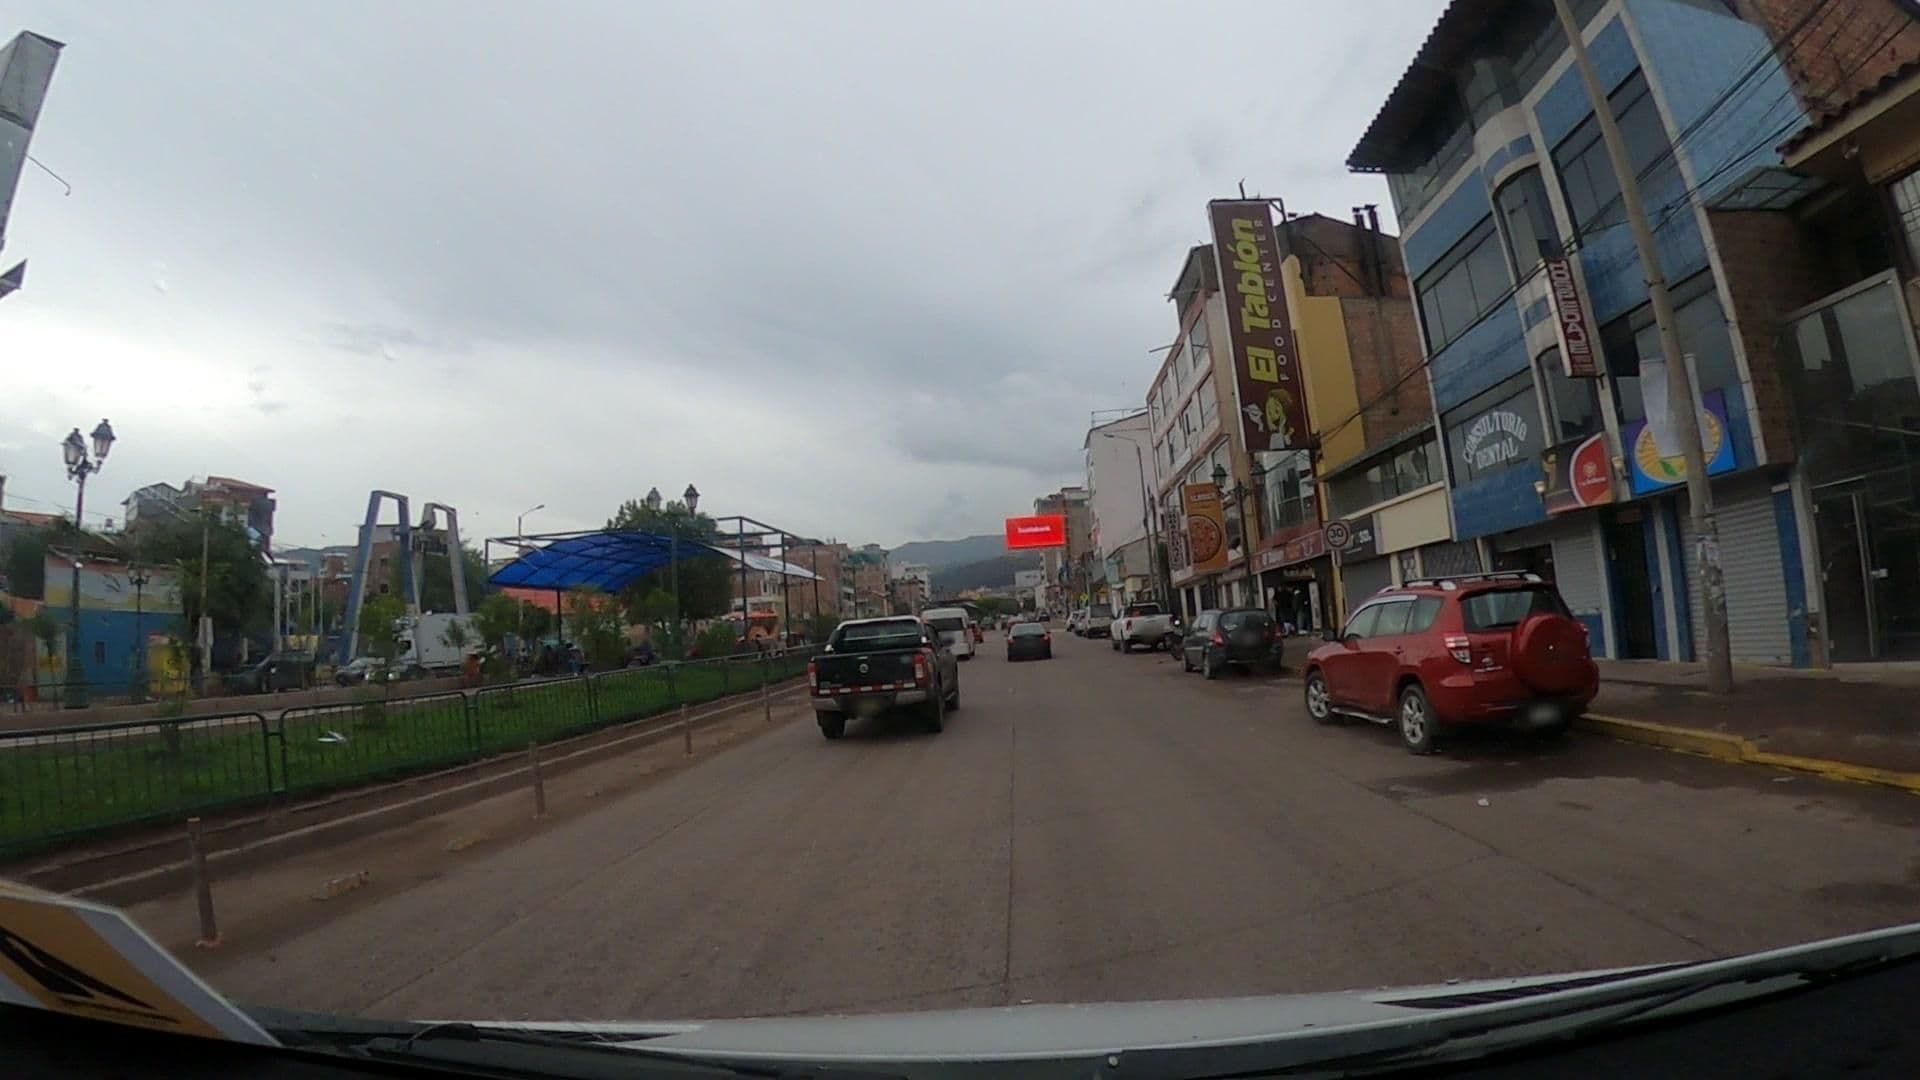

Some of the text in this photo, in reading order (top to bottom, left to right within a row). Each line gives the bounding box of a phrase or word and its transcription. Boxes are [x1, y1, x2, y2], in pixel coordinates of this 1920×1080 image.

[1226, 218, 1279, 383] El Tablón
[1254, 219, 1291, 382] FOOD CENTER
[1463, 411, 1528, 464] CONSULTORIO
[1476, 437, 1519, 470] DENTAL
[1329, 527, 1344, 538] 30
